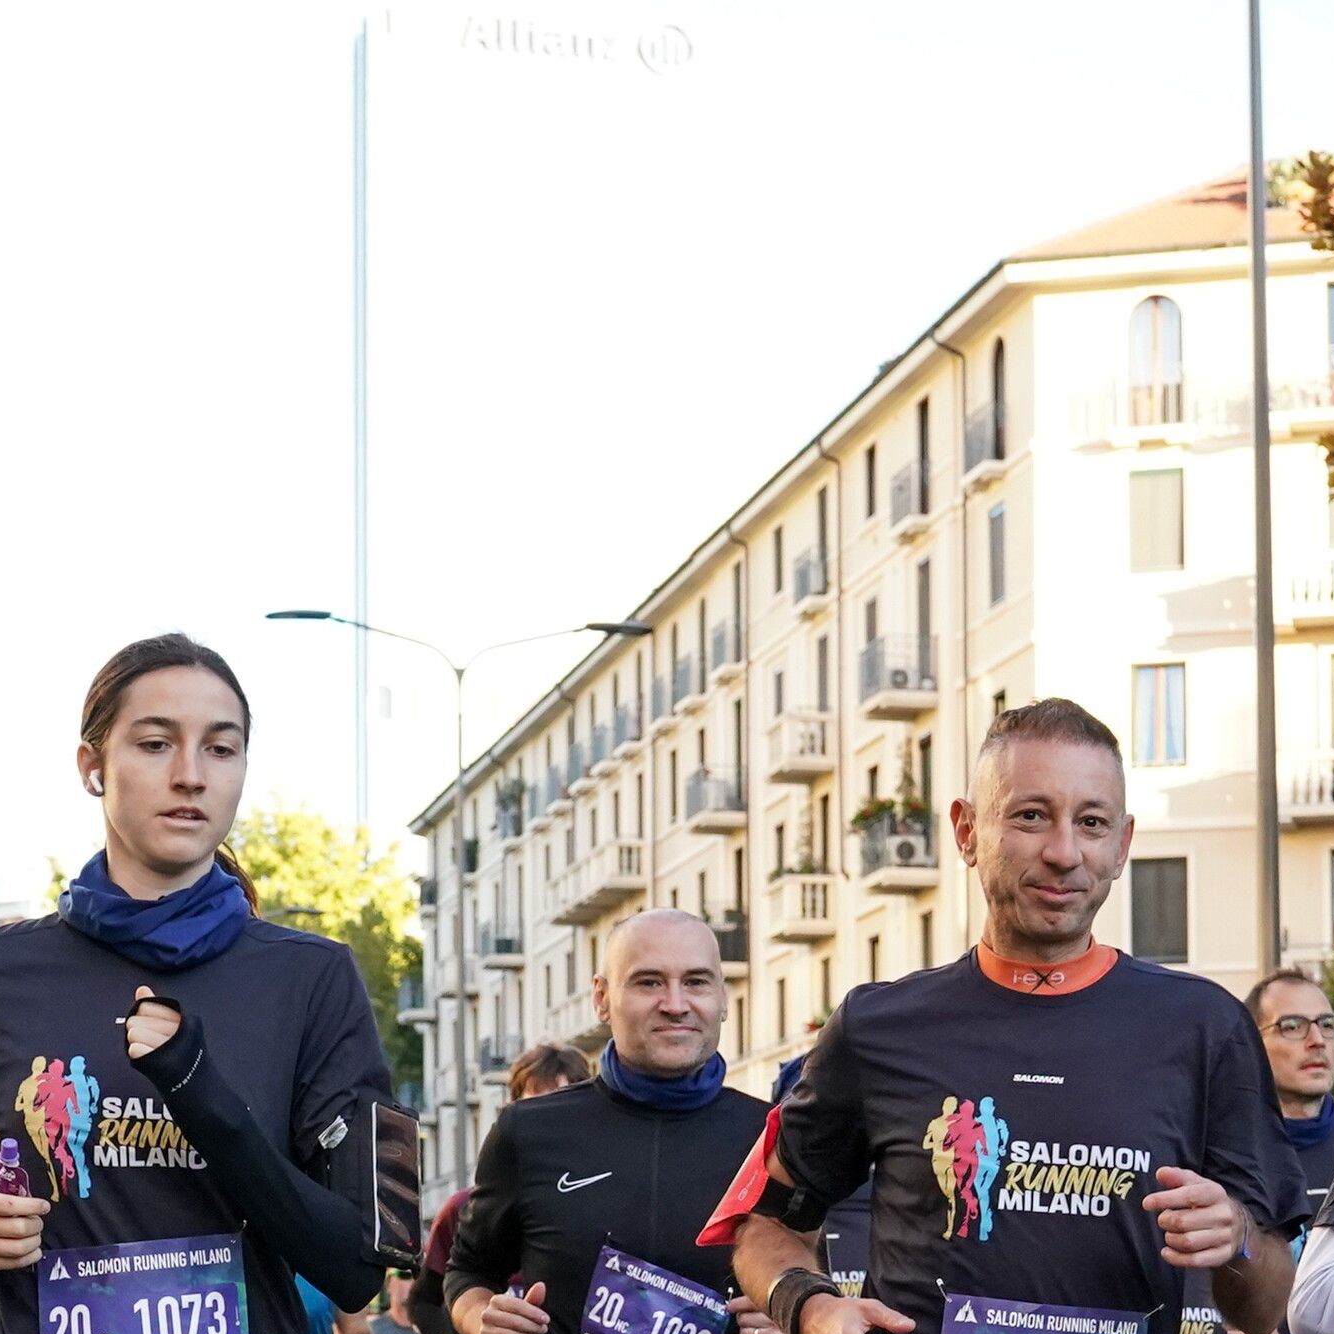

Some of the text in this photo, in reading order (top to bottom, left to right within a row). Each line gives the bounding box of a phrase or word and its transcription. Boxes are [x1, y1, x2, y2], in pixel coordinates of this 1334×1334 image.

[461, 15, 617, 62] Allianz
[1013, 1074, 1065, 1084] SALOMON
[1010, 1140, 1151, 1174] SALOMON
[1005, 1162, 1136, 1201] RUNNING
[998, 1188, 1111, 1218] MILANO
[78, 1247, 232, 1278] SALOMON RUNNING MILANO
[625, 1264, 667, 1290] SALOMON
[665, 1280, 705, 1306] RUNNING
[986, 1309, 1044, 1330] SALOMON
[1046, 1315, 1097, 1334] RUNNING
